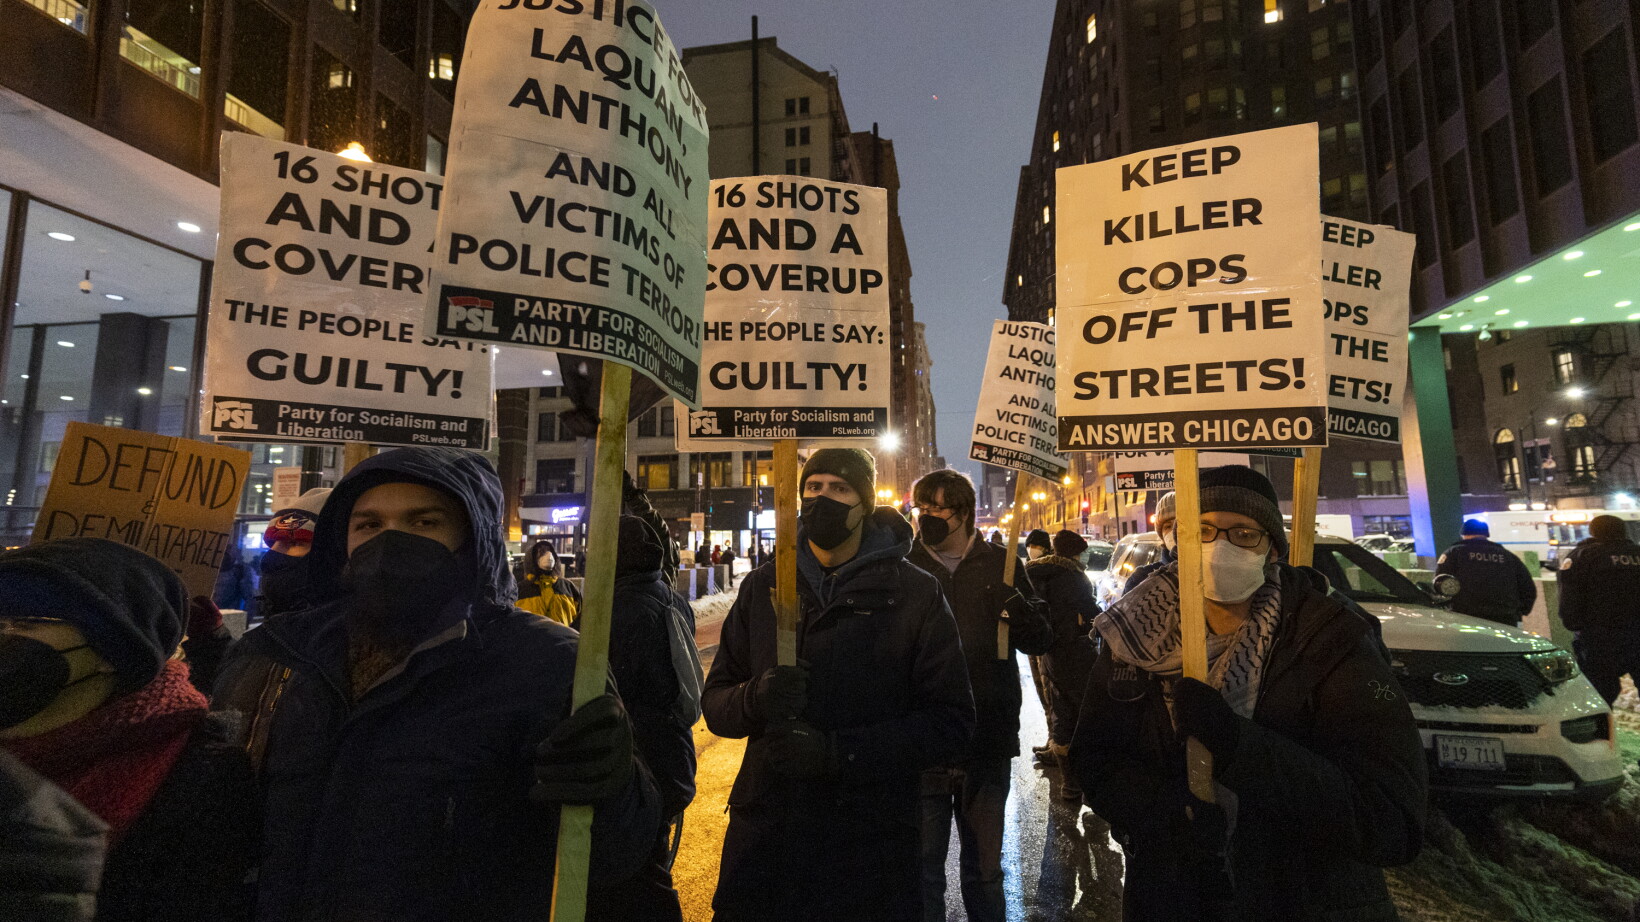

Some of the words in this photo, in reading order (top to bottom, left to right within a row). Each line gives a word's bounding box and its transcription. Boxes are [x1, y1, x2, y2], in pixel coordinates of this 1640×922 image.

[531, 27, 687, 157] LAQUAN,
[668, 53, 704, 130] FOR
[508, 77, 692, 200] ANTHONY
[273, 151, 319, 184] 16
[332, 165, 443, 210] SHOT
[1121, 145, 1241, 192] KEEP
[544, 152, 637, 198] AND
[643, 187, 676, 240] ALL
[714, 184, 746, 208] 16
[756, 181, 860, 215] SHOTS
[265, 191, 411, 246] AND
[1104, 198, 1263, 246] KILLER
[509, 191, 660, 266] VICTIMS
[663, 252, 685, 290] OF
[711, 218, 817, 251] AND
[830, 223, 864, 255] A
[1321, 220, 1375, 249] EEP
[233, 237, 431, 294] COVER
[1118, 254, 1248, 295] COPS
[448, 232, 611, 288] POLICE
[622, 263, 700, 349] TERROR!
[225, 299, 289, 329] THE
[298, 309, 414, 343] PEOPLE
[446, 305, 499, 334] PSL
[704, 321, 733, 341] HE
[740, 321, 825, 342] PEOPLE
[832, 324, 884, 345] SAY:
[998, 323, 1055, 345] JUSTIC
[1082, 307, 1177, 345] OFF
[1188, 298, 1293, 334] THE
[511, 322, 562, 346] AND
[568, 330, 660, 377] LIBERATION
[513, 298, 592, 326] PARTY
[598, 310, 634, 337] FOR
[638, 324, 684, 373] SOCIALISM
[1331, 333, 1389, 363] THE
[1008, 344, 1056, 369] LAQU
[246, 348, 464, 399] GUILTY!
[664, 370, 694, 400] PSLweb.org
[709, 361, 868, 391] GUILTY!
[1000, 365, 1056, 392] ANTHO
[1073, 358, 1306, 400] STREETS!
[1008, 394, 1040, 409] AND
[1328, 374, 1392, 406] ETS!
[213, 407, 258, 431] PSL
[277, 421, 364, 441] Liberation
[278, 404, 325, 425] Party
[330, 409, 354, 424] for
[359, 411, 436, 431] Socialism
[441, 420, 468, 433] and
[690, 417, 722, 435] PSL
[734, 410, 767, 425] Party
[770, 409, 787, 422] for
[791, 409, 850, 422] Socialism
[853, 409, 875, 422] and
[734, 424, 797, 437] Liberation
[832, 427, 876, 437] PSLweb.org
[996, 409, 1048, 433] VICTIMS
[1049, 425, 1058, 438] O
[1068, 421, 1176, 446] ANSWER
[1183, 416, 1313, 443] CHICAGO
[1328, 414, 1391, 437] HICAGO
[412, 433, 467, 447] PSLweb.org
[975, 424, 1026, 444] POLICE
[972, 448, 988, 460] PSL
[991, 456, 1007, 464] AND
[1008, 459, 1044, 476] LIBERATION
[992, 447, 1017, 459] PARTY
[1018, 453, 1032, 462] FOR
[1032, 456, 1060, 472] SOCIALISM
[69, 436, 237, 510] DEFUND
[1118, 478, 1137, 488] PSL
[1144, 471, 1165, 480] Party
[1469, 552, 1505, 563] POLICE
[1453, 747, 1467, 762] 19
[1474, 748, 1498, 763] 711
